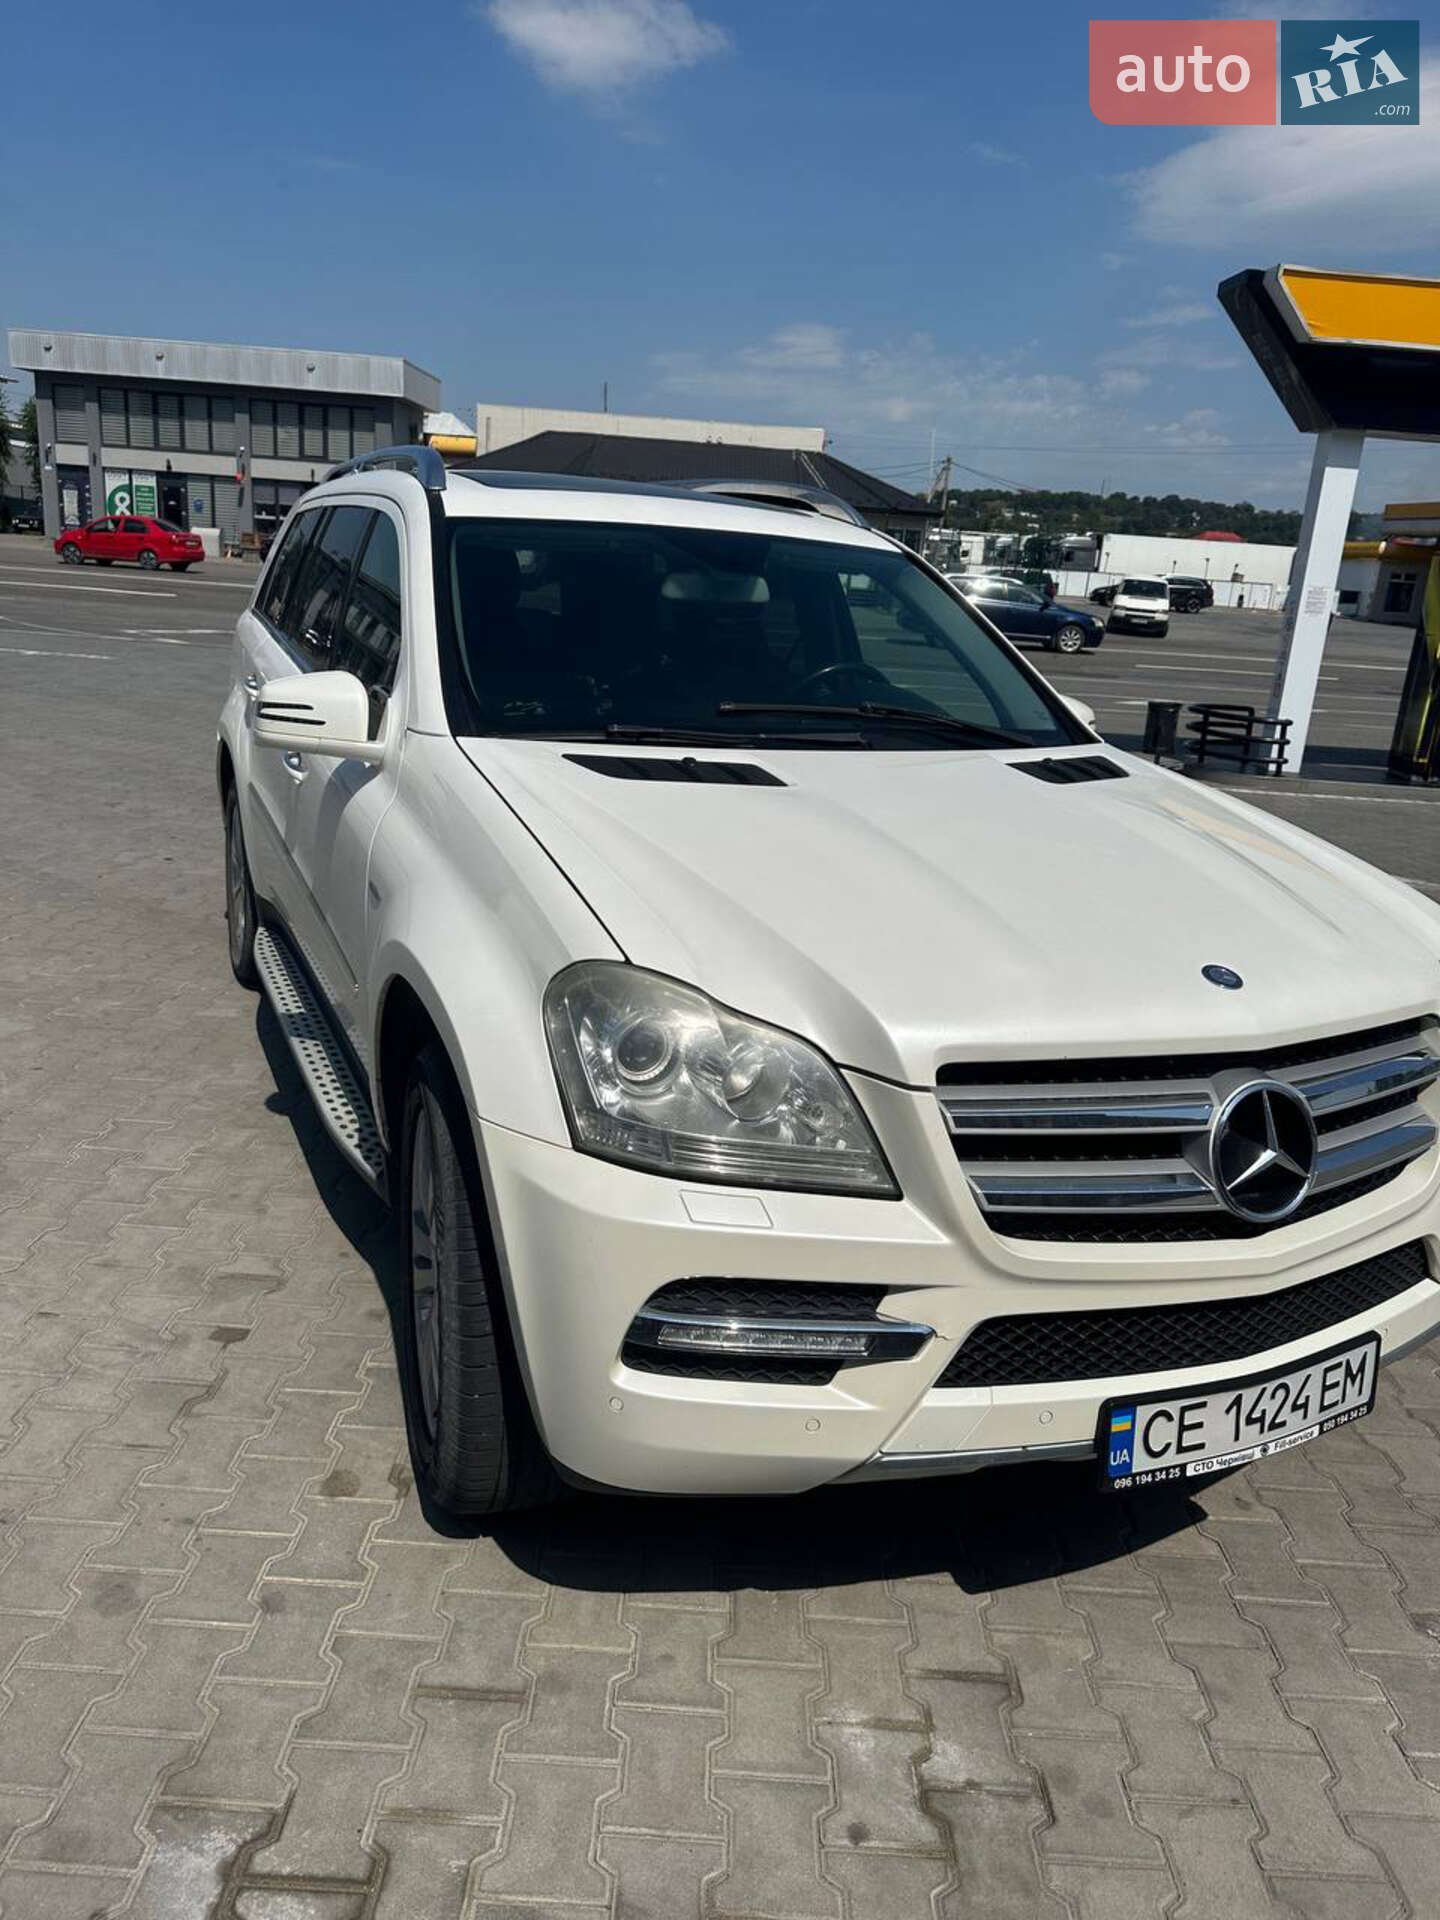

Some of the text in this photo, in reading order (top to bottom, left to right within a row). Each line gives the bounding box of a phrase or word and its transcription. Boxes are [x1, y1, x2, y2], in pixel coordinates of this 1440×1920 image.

[1142, 1351, 1368, 1459] CE 1424 EM
[1110, 1448, 1131, 1466] UA
[1114, 1467, 1181, 1489] 096 194 34 25
